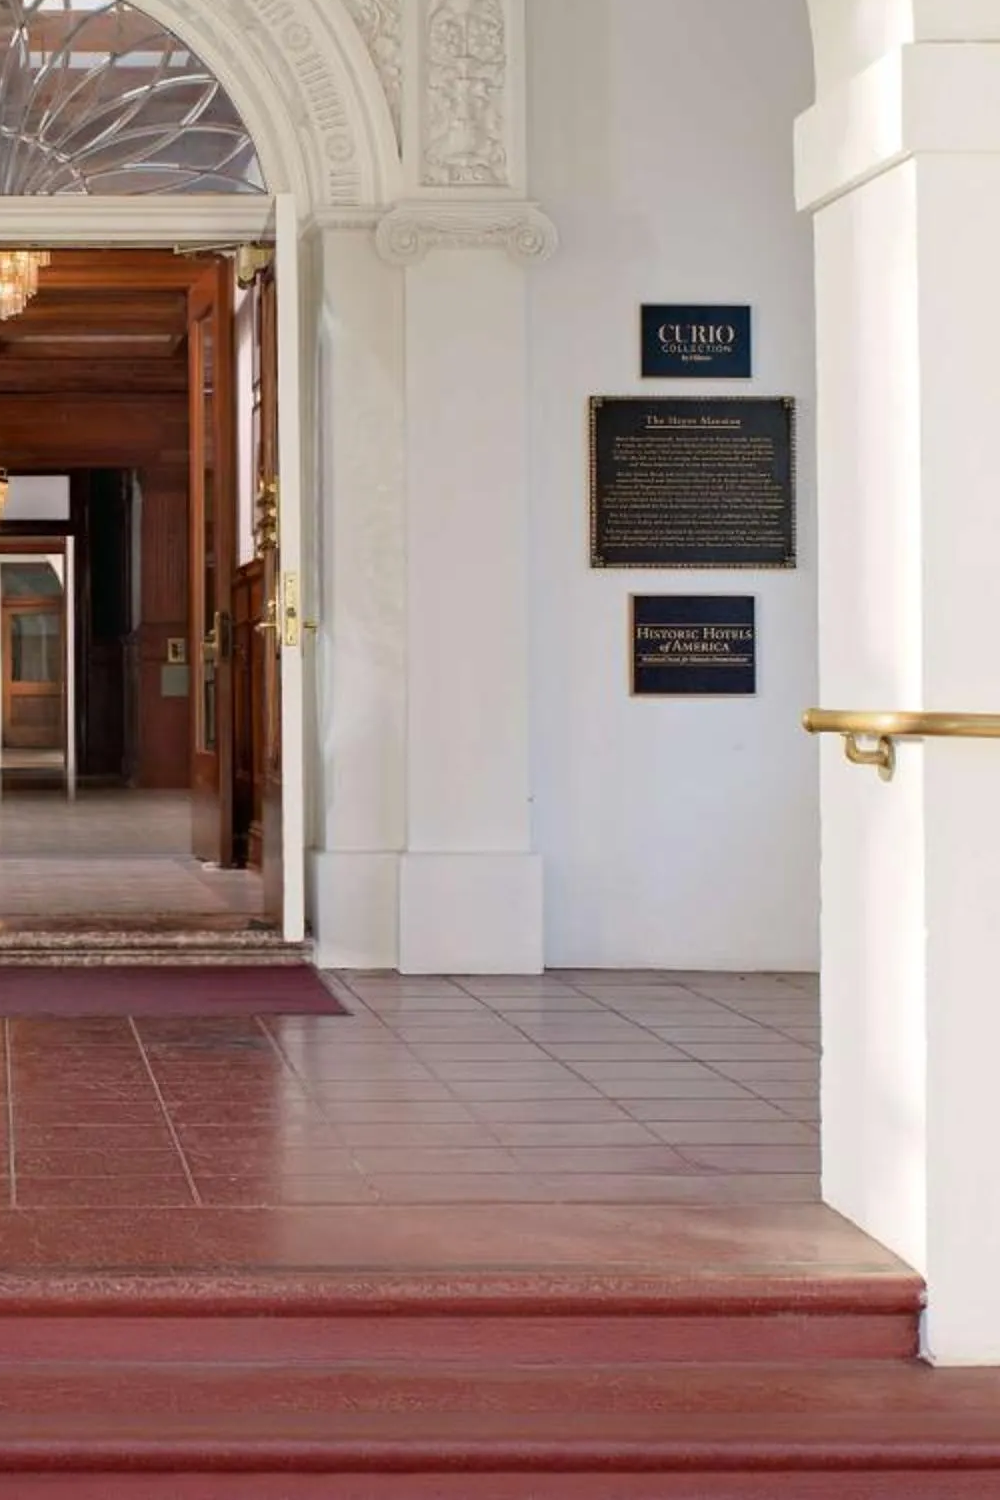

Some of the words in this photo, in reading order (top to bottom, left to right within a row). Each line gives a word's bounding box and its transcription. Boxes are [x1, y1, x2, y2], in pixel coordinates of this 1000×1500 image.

[658, 323, 735, 343] CURIO
[661, 343, 732, 353] COLLECTION
[647, 415, 664, 425] The
[700, 415, 741, 425] Mansion
[636, 627, 700, 639] HISTORIC
[703, 627, 753, 640] HOTELS
[659, 641, 671, 654] of
[672, 640, 730, 652] AMERICA
